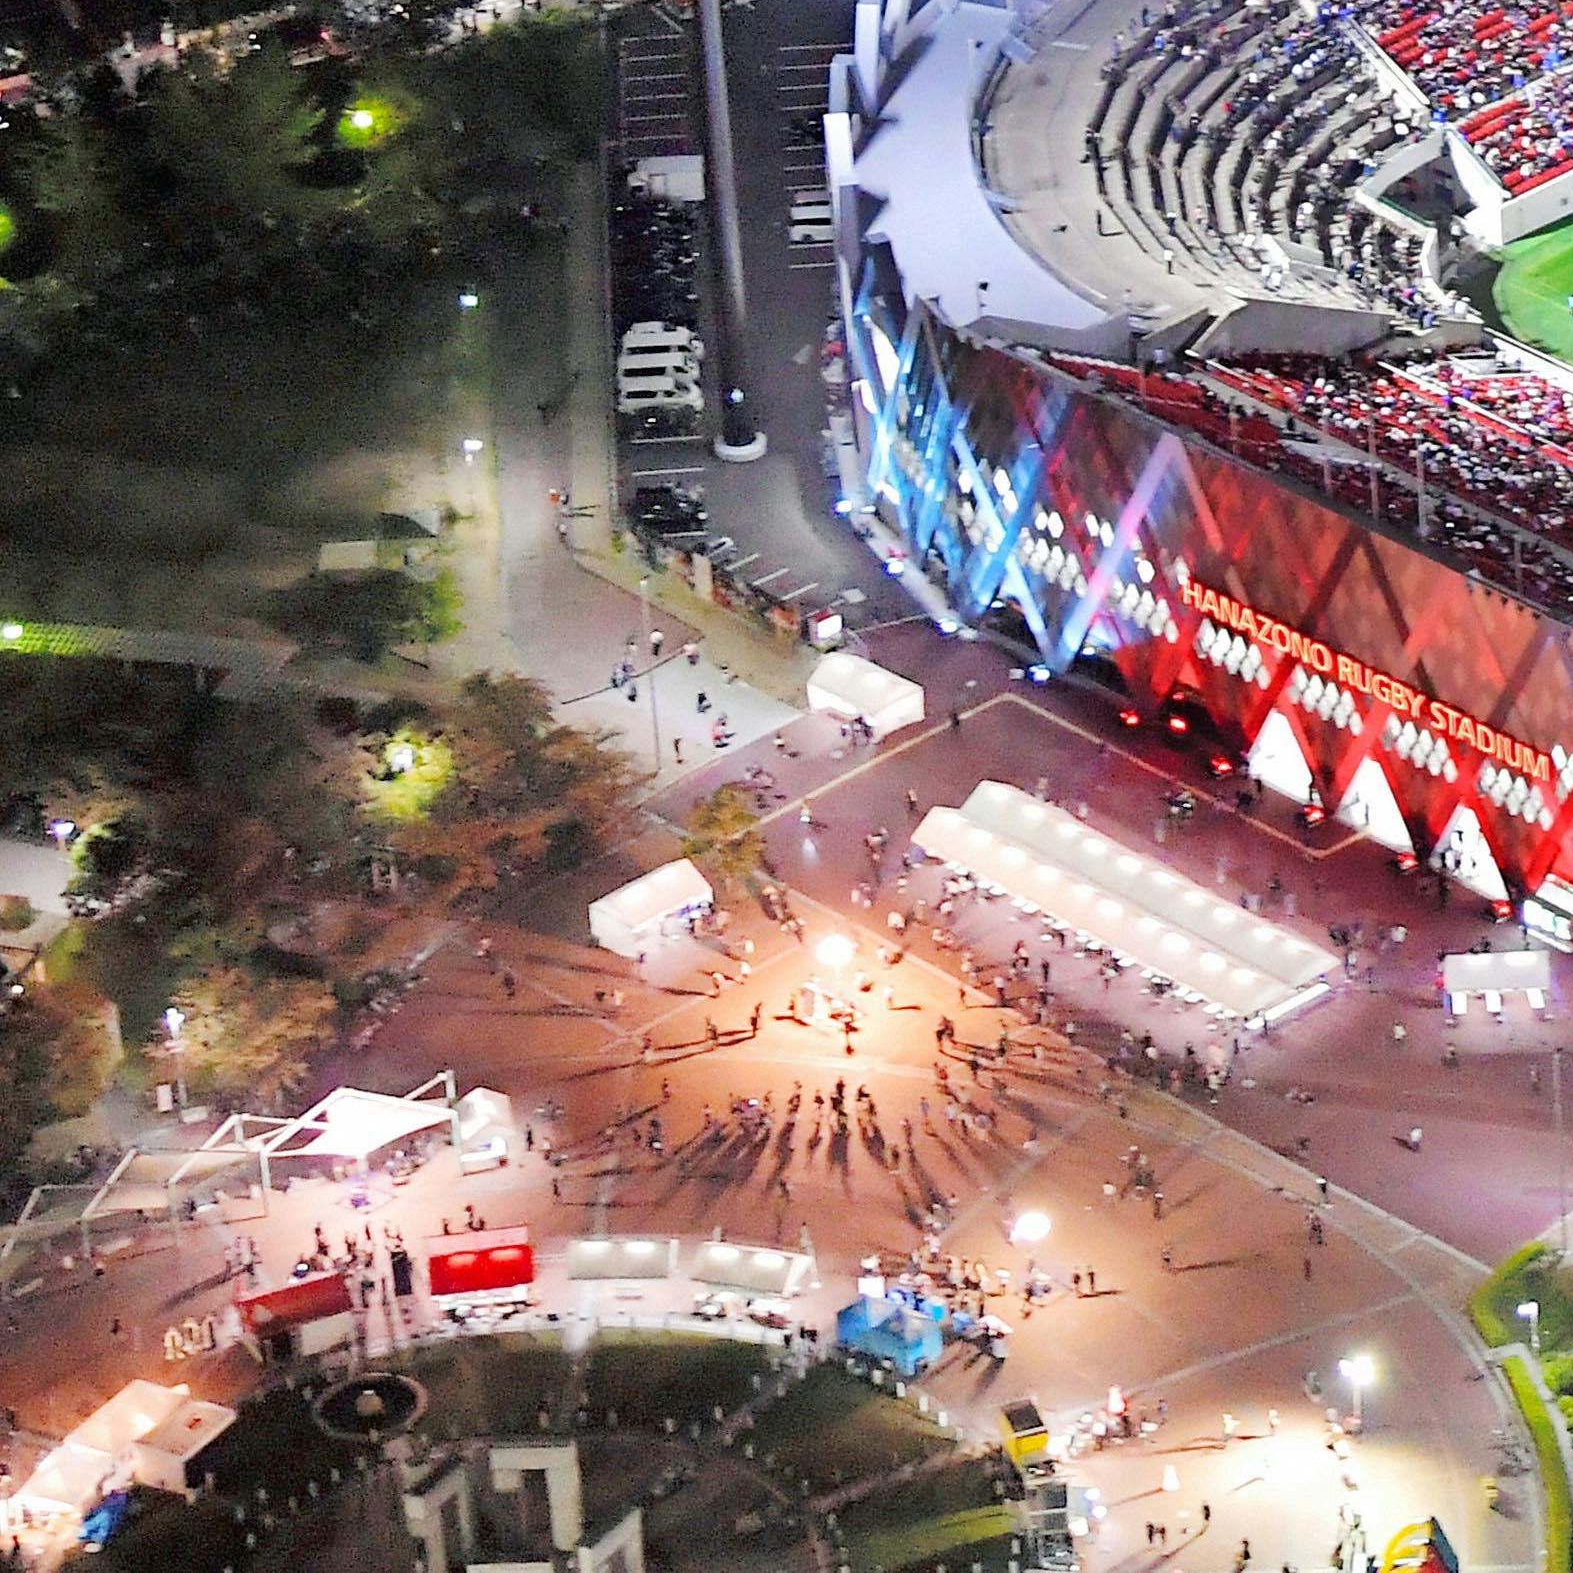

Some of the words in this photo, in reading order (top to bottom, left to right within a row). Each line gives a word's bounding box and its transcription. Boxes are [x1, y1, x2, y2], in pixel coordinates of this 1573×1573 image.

[1182, 581, 1332, 672] HANAZONO
[1337, 654, 1426, 718] RUGBY
[1429, 701, 1550, 781] STADIUM
